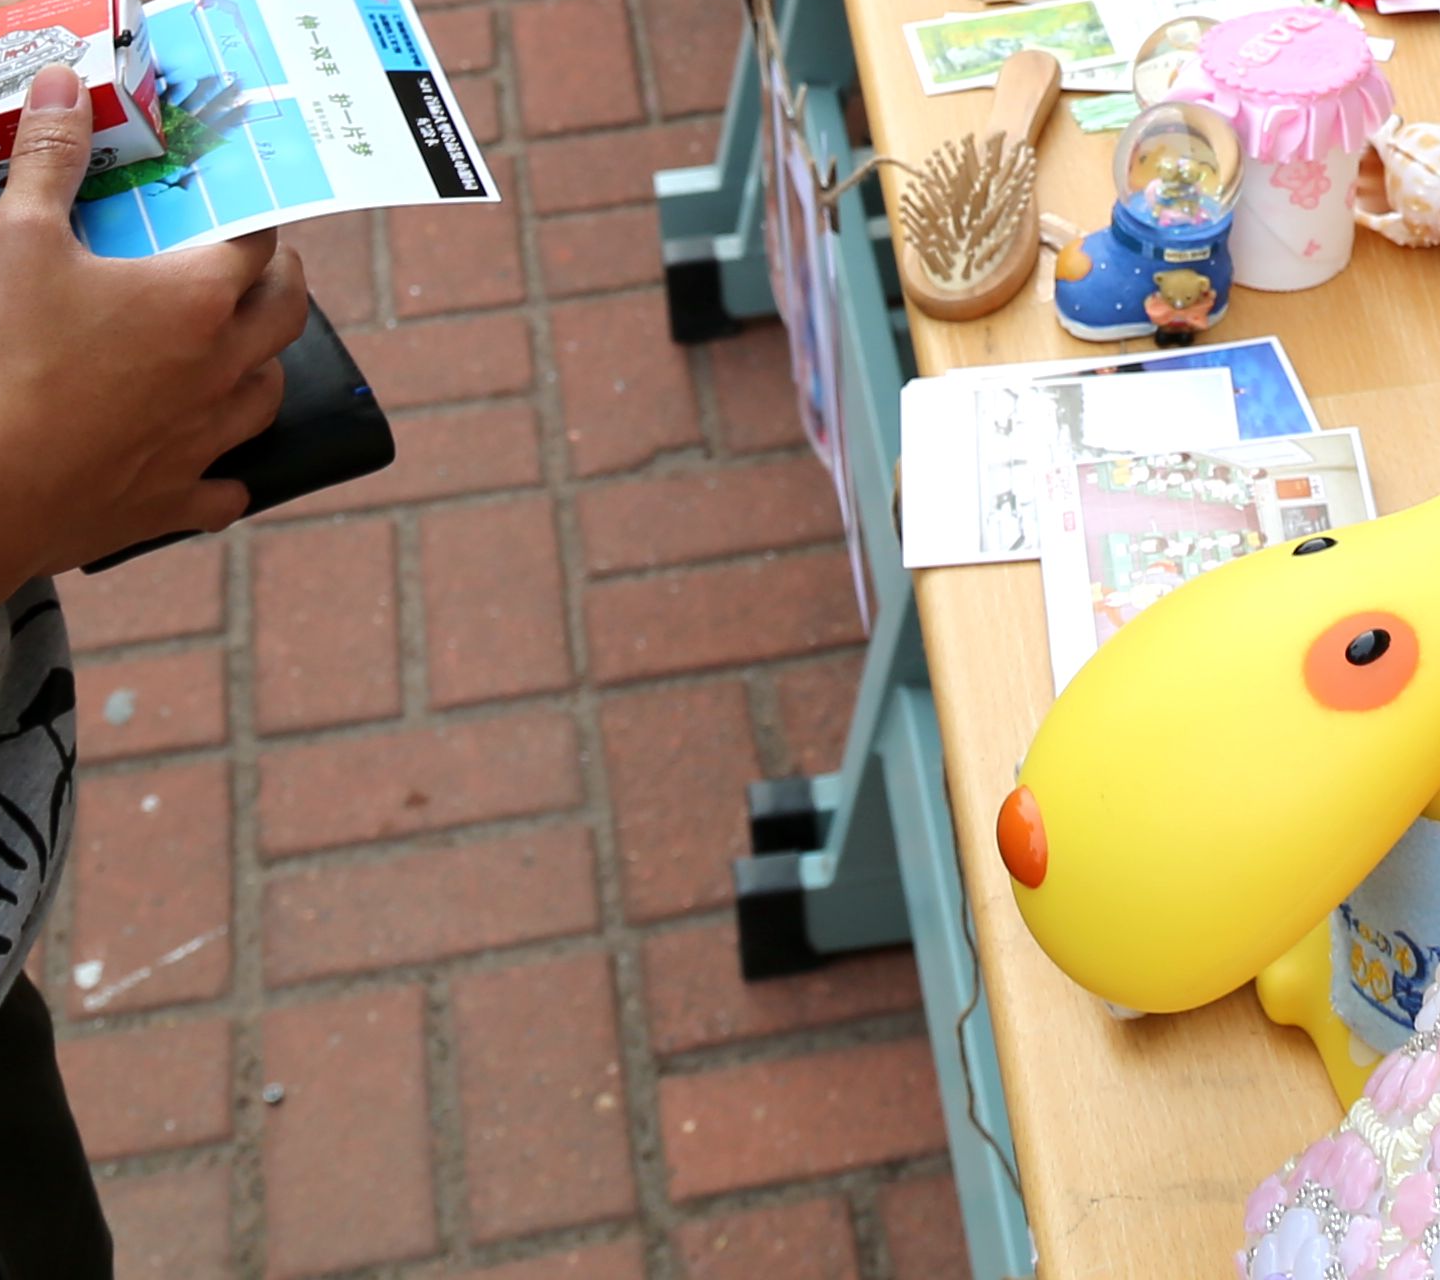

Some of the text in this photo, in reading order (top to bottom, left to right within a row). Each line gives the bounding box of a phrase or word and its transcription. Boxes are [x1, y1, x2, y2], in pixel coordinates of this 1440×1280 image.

[295, 14, 340, 77] 伸一双手
[328, 92, 374, 157] 护一片梦
